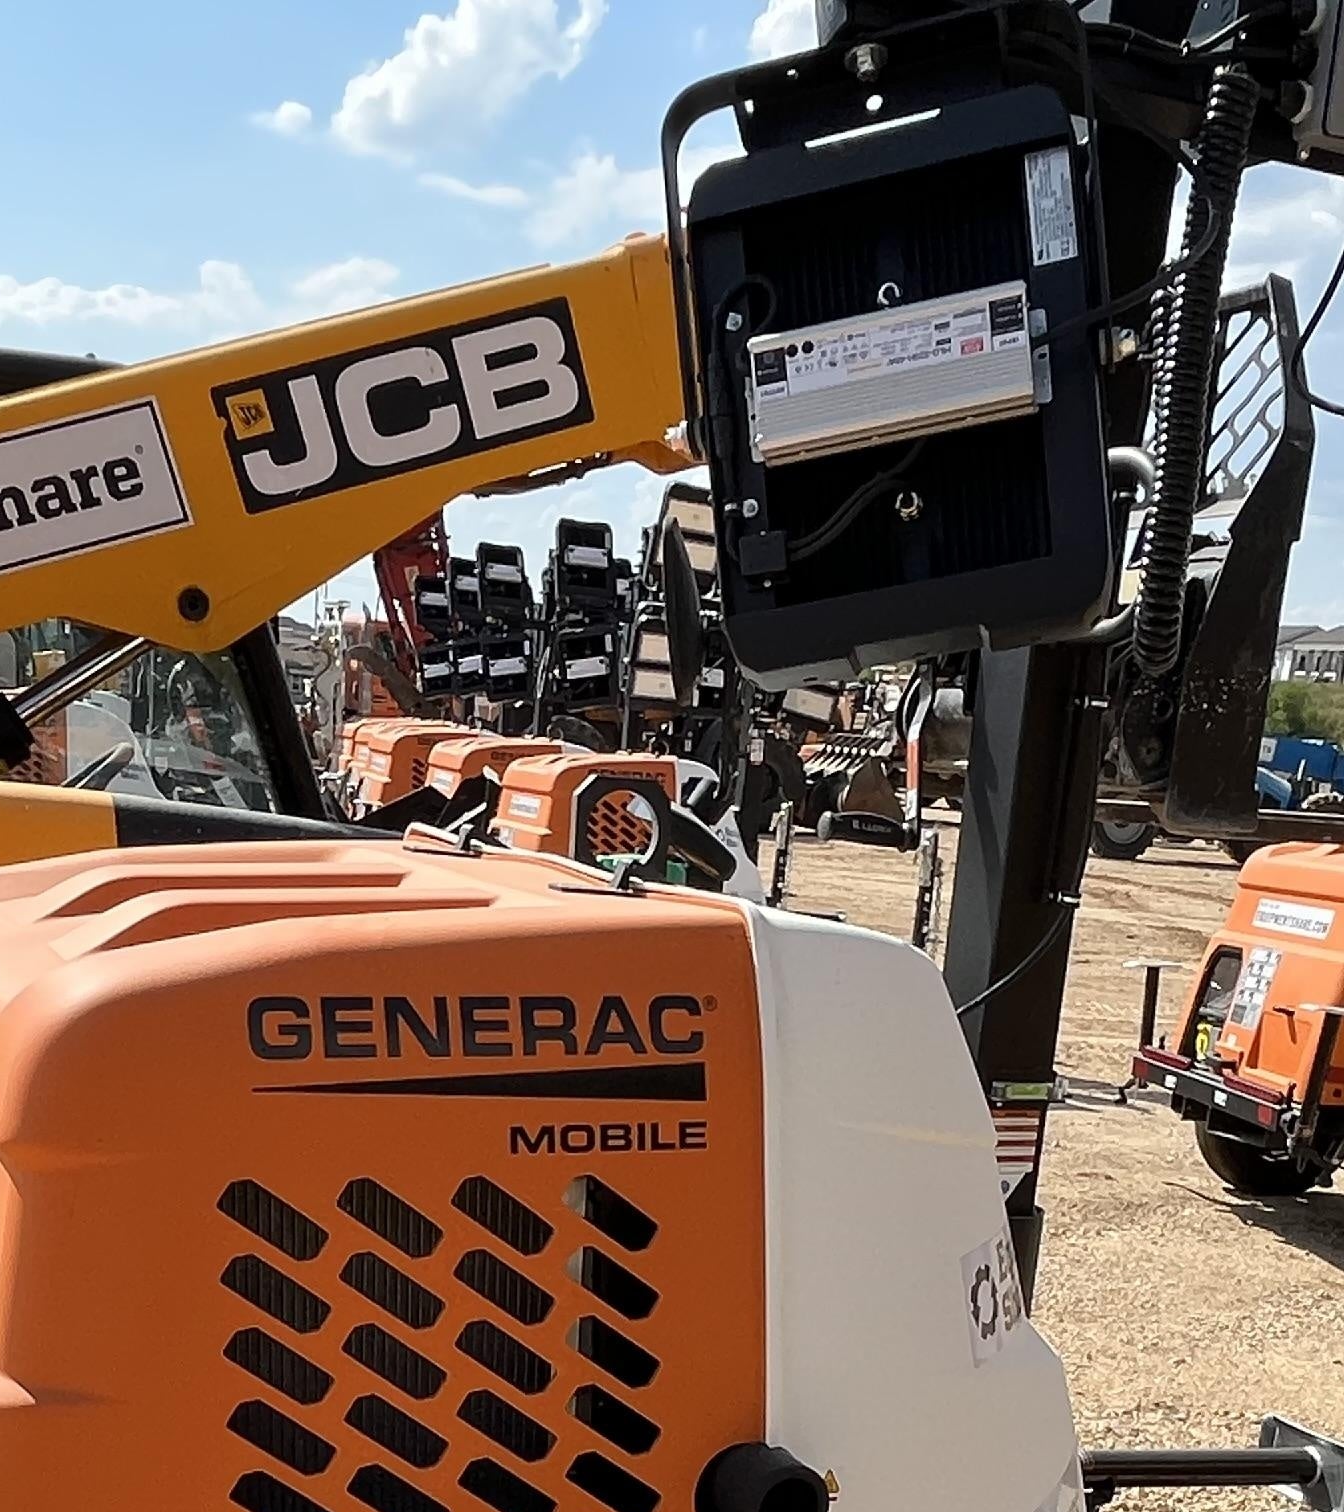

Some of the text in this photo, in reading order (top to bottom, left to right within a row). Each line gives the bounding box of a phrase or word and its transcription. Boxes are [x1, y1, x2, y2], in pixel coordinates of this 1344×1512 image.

[242, 316, 579, 495] JCB
[248, 996, 704, 1060] GENERAC
[509, 1121, 707, 1154] MOBILE
